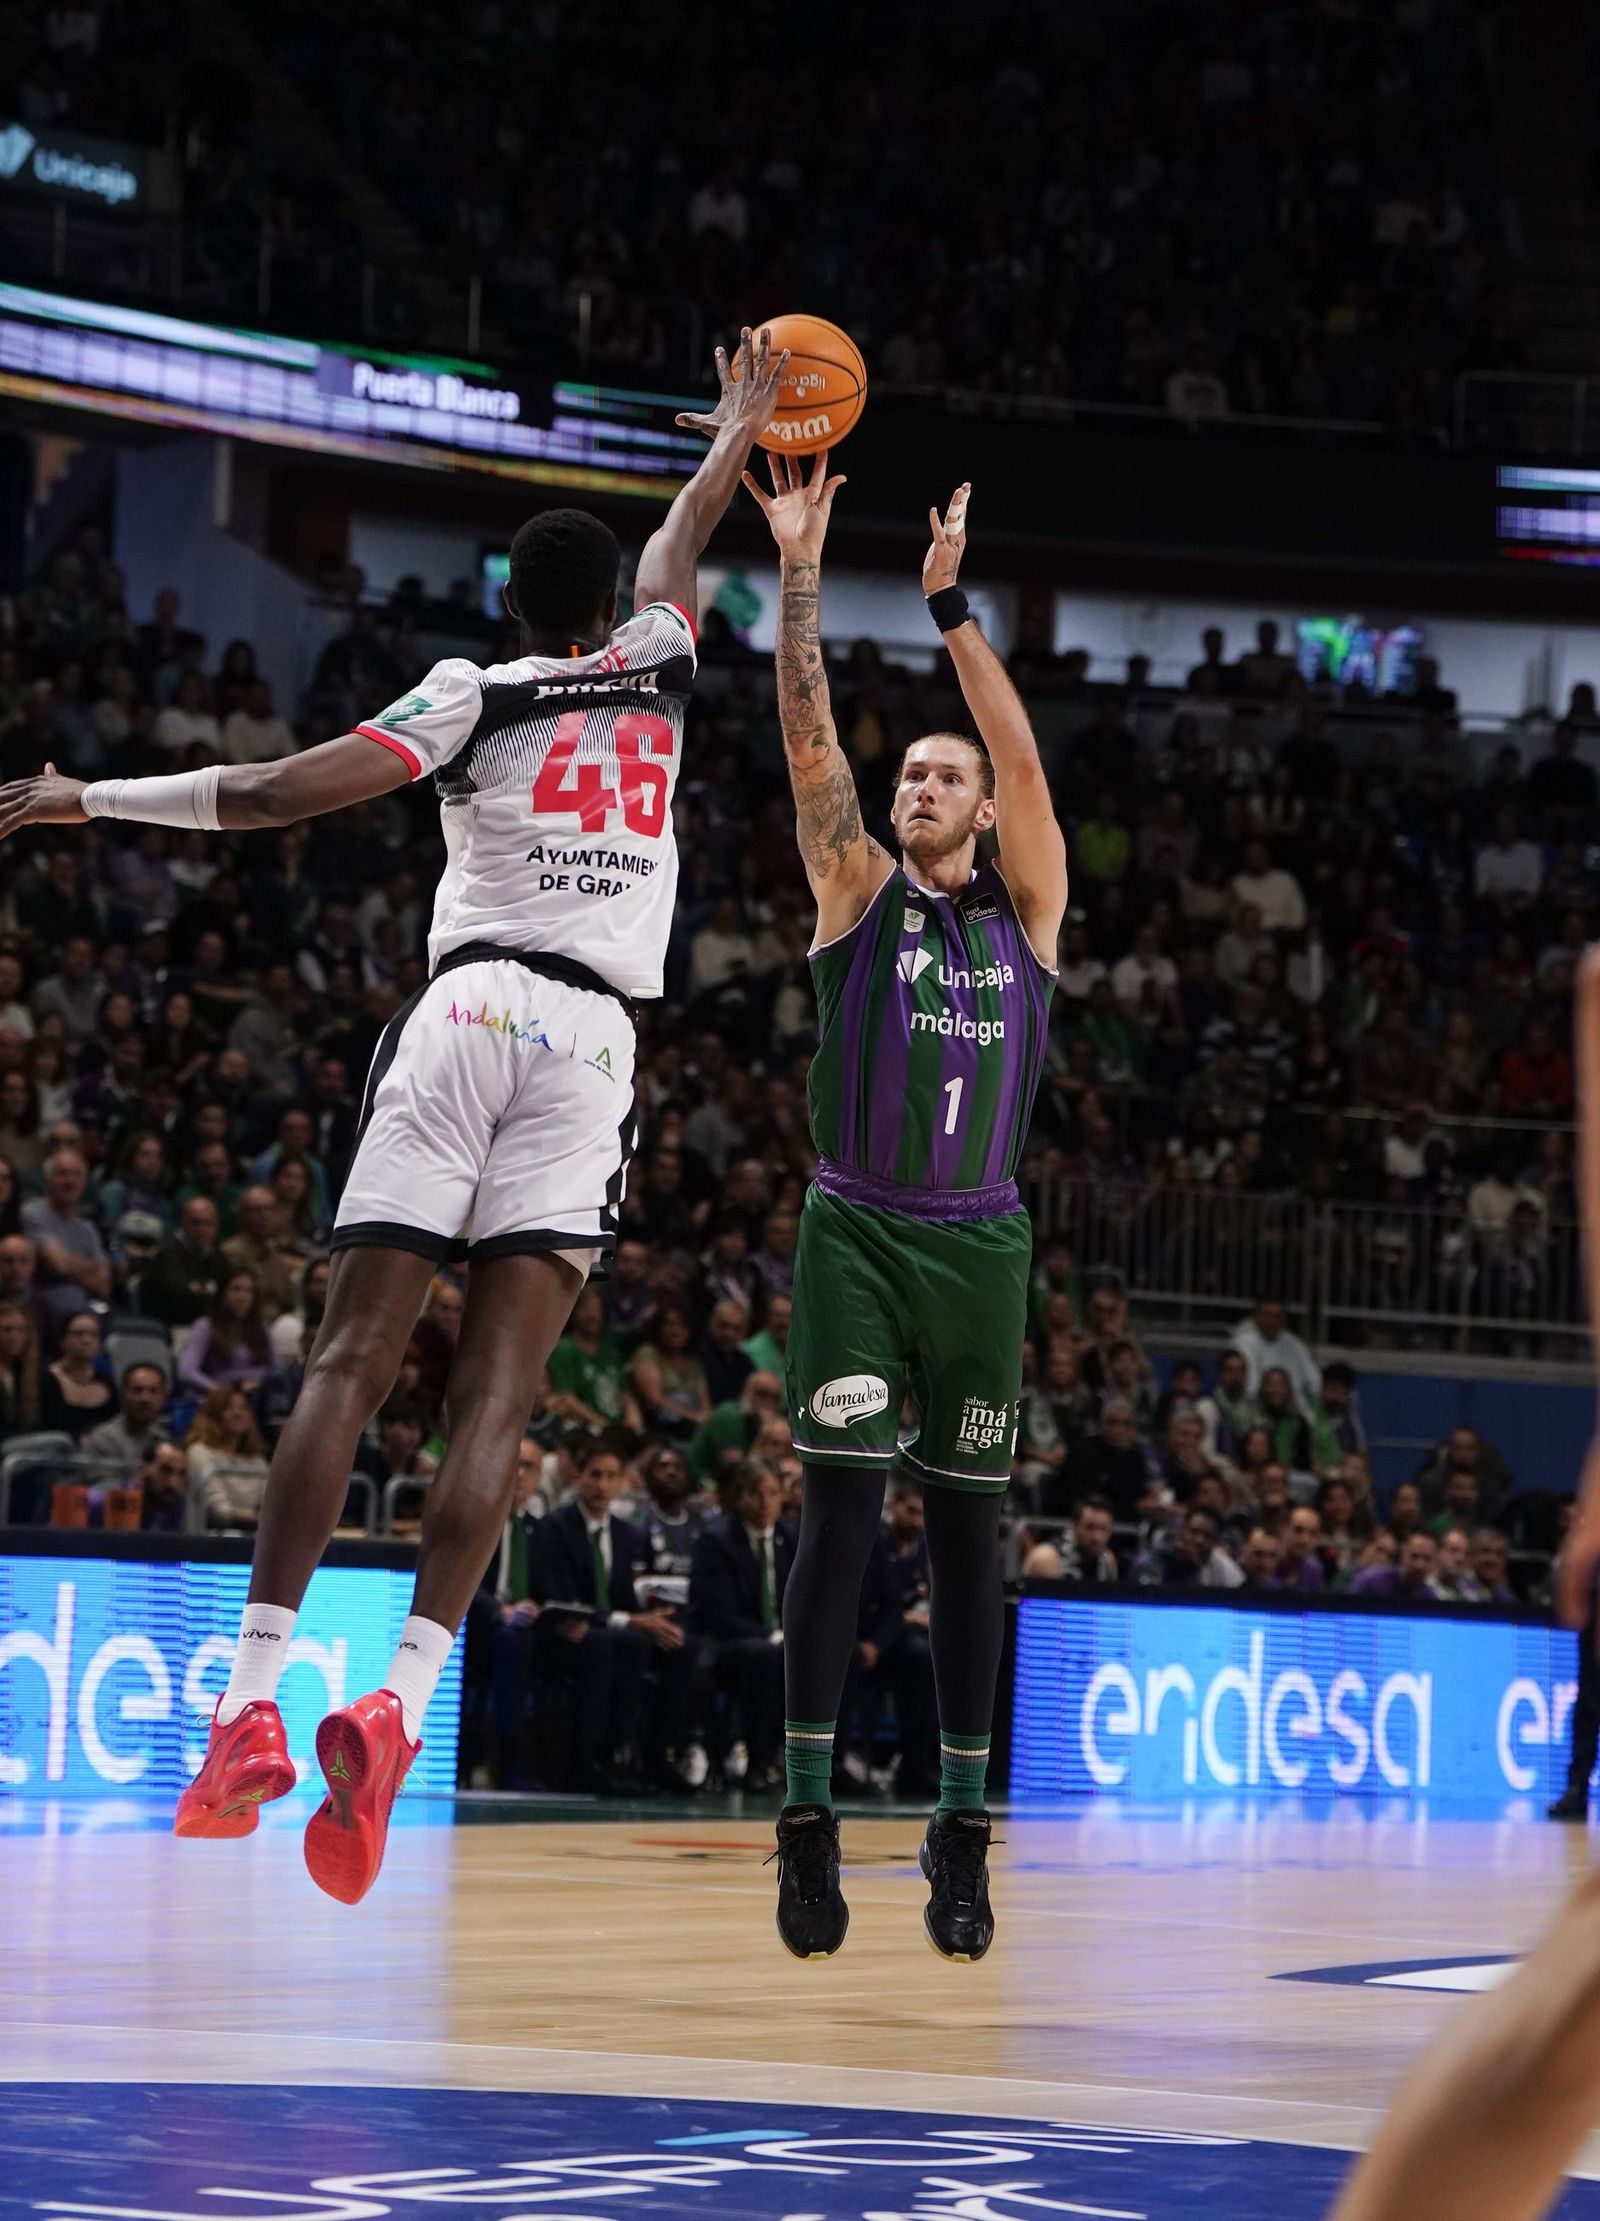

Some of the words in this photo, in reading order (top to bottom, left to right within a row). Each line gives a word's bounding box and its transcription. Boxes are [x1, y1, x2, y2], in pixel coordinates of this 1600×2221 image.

[33, 147, 137, 204] Unicaja
[532, 711, 674, 839] 46
[526, 844, 658, 878] AYUNTAMIEN
[539, 874, 569, 891] DE
[577, 874, 632, 898] GRA
[944, 1076, 964, 1136] 1
[816, 1380, 887, 1415] famadesa
[0, 1581, 348, 1784] desa
[1080, 1630, 1432, 1787] endesa
